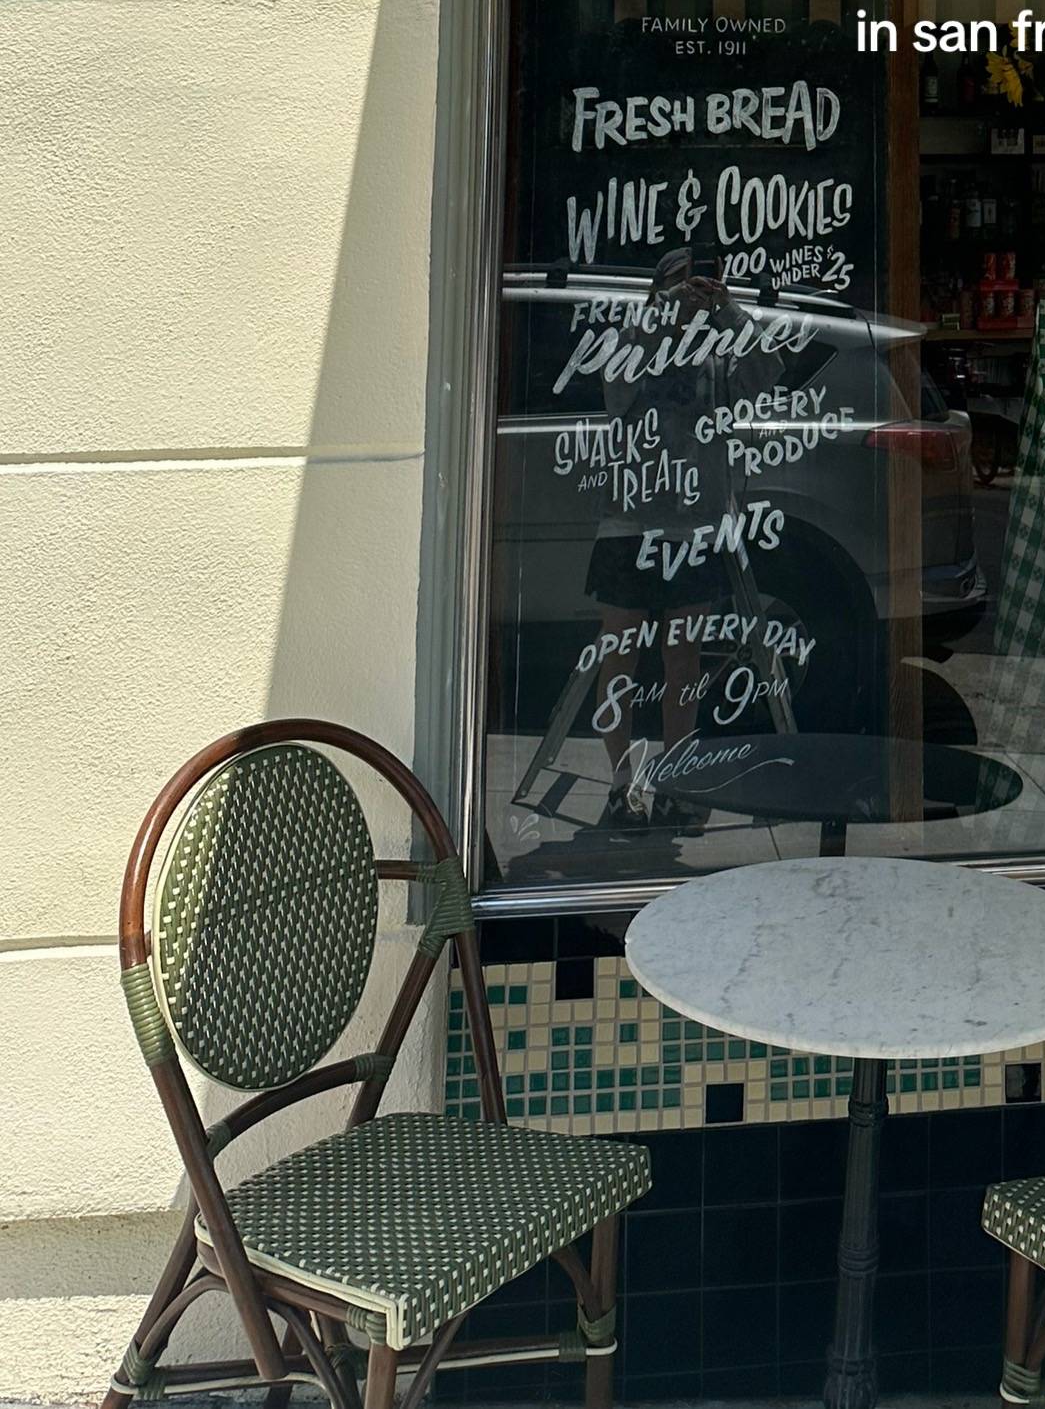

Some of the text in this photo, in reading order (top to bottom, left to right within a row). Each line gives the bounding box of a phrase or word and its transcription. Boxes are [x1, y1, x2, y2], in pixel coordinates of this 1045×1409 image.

[641, 16, 787, 34] FAMILY OWNED
[675, 40, 747, 56] EST. 1911
[571, 80, 841, 152] FRESH BREAD
[567, 165, 853, 264] WINE & COOKIES
[721, 246, 767, 284] 100
[769, 245, 824, 274] WINES
[771, 263, 821, 290] UNDER
[569, 299, 681, 334] FRENCH
[552, 309, 821, 394] Pastries
[553, 407, 661, 476] SNACKS
[694, 385, 827, 444] GROCERY
[725, 407, 855, 476] PRODUCE
[577, 448, 701, 513] AND TREATS
[635, 500, 785, 581] EVENTS
[575, 612, 817, 673] OPEN EVERY DAY
[679, 672, 709, 707] til
[614, 728, 776, 801] Welcome
